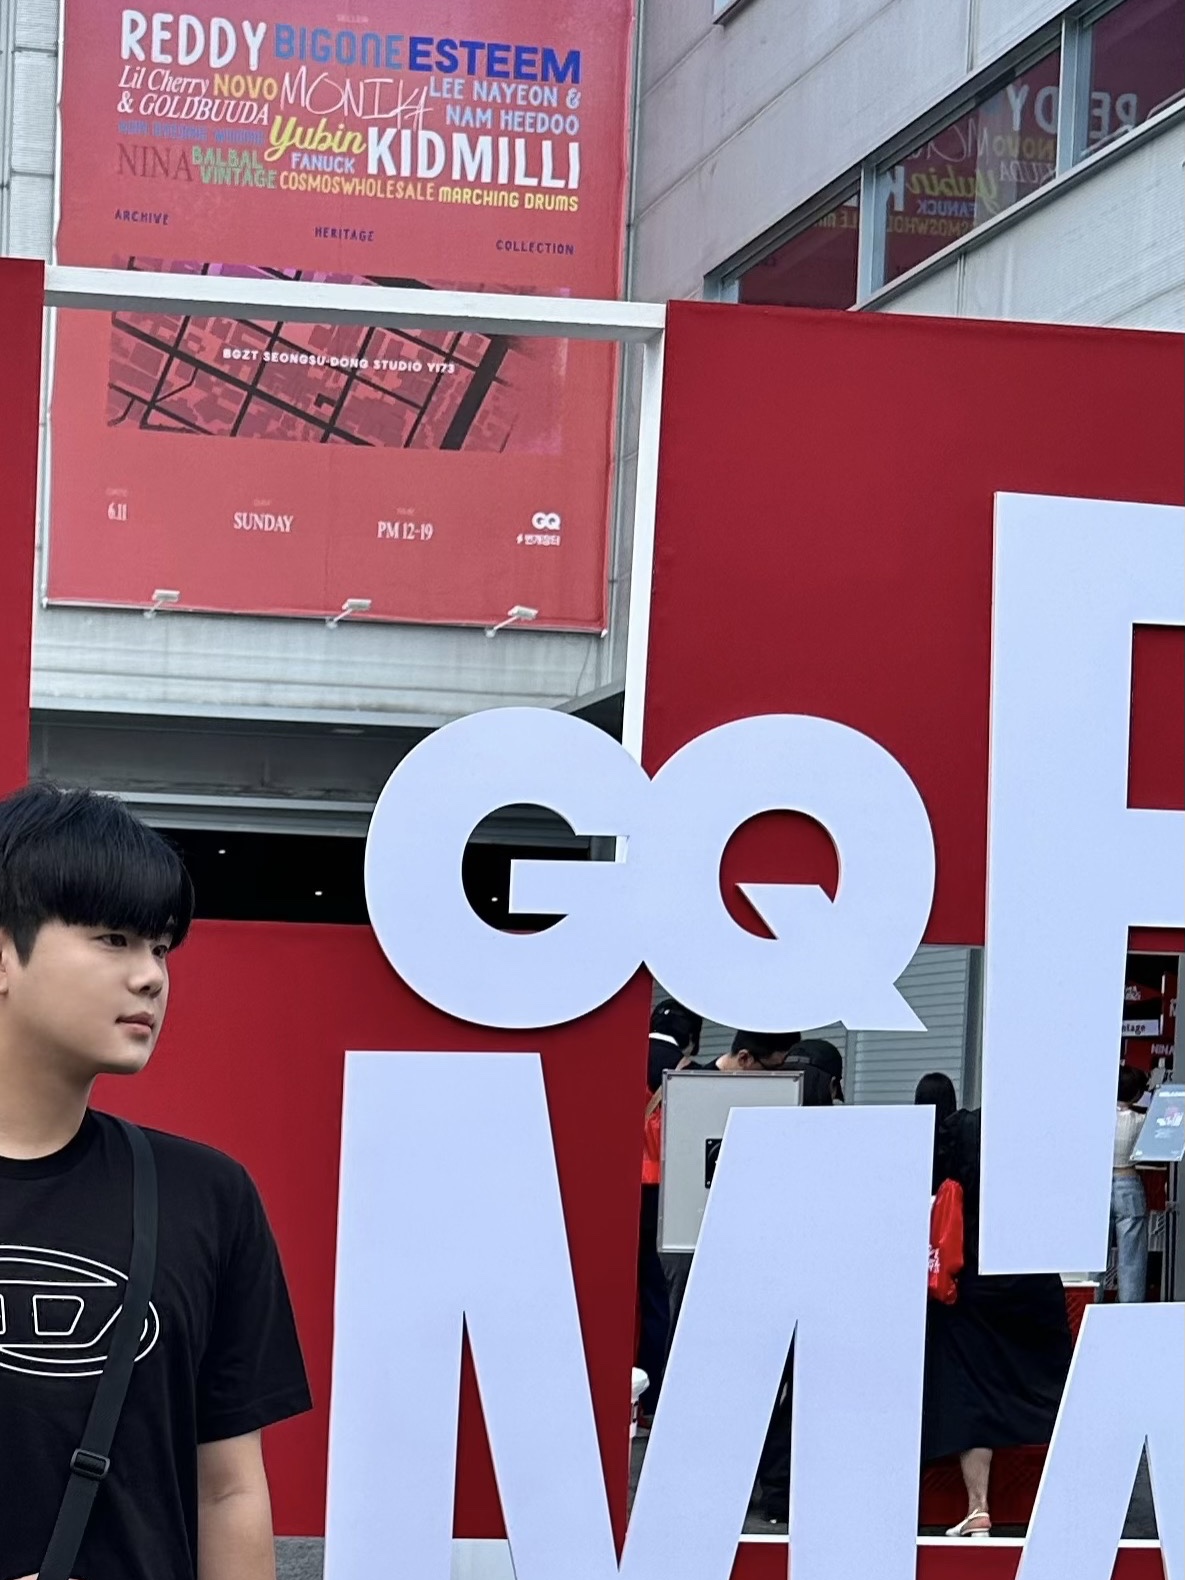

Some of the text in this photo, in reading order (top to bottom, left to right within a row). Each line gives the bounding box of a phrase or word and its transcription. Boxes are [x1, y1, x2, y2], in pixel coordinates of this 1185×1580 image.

[121, 9, 581, 84] REDDY BIGONE ESTEEM
[118, 65, 209, 98] Lil Cherry
[213, 73, 278, 100] NOVO
[429, 76, 581, 109] LEE NAYEON &
[117, 91, 269, 125] & GOLDBUUDA
[445, 104, 580, 136] NAM HEEDOO
[263, 115, 367, 162] Yubin
[117, 143, 193, 182] NINA
[192, 146, 264, 170] BALBAL
[290, 152, 356, 174] FANUCK
[200, 166, 277, 189] VINTAGE
[438, 186, 579, 212] MARCHING DRUMS
[115, 209, 169, 225] ARCHIVE
[314, 227, 375, 242] HERITAGE
[496, 239, 575, 256] COLLECTION
[373, 358, 423, 373] STUDIO
[233, 511, 294, 533] SUNDAY
[377, 521, 434, 541] PM 12-19
[531, 511, 561, 531] GQ
[364, 704, 935, 1033] GQ
